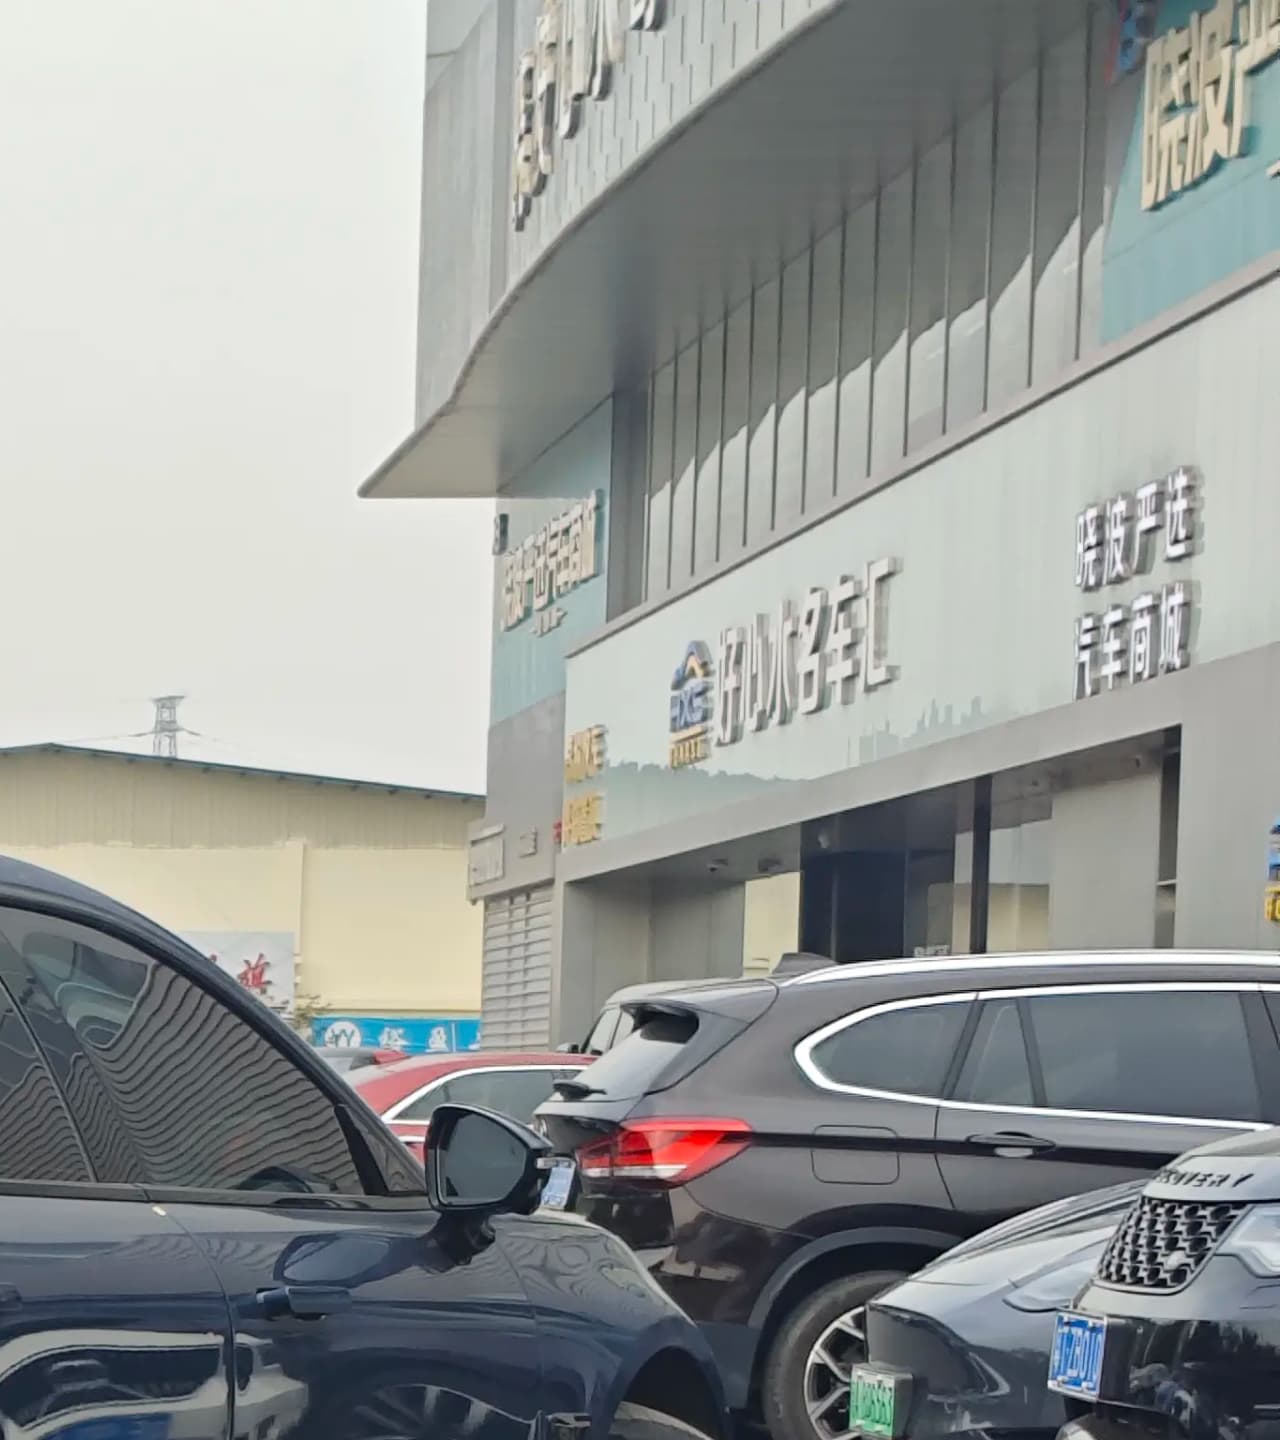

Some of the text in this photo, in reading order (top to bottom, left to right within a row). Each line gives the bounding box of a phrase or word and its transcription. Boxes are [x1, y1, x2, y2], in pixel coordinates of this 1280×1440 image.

[1074, 467, 1196, 590] 晓波严选
[1073, 582, 1190, 699] 汽车商城
